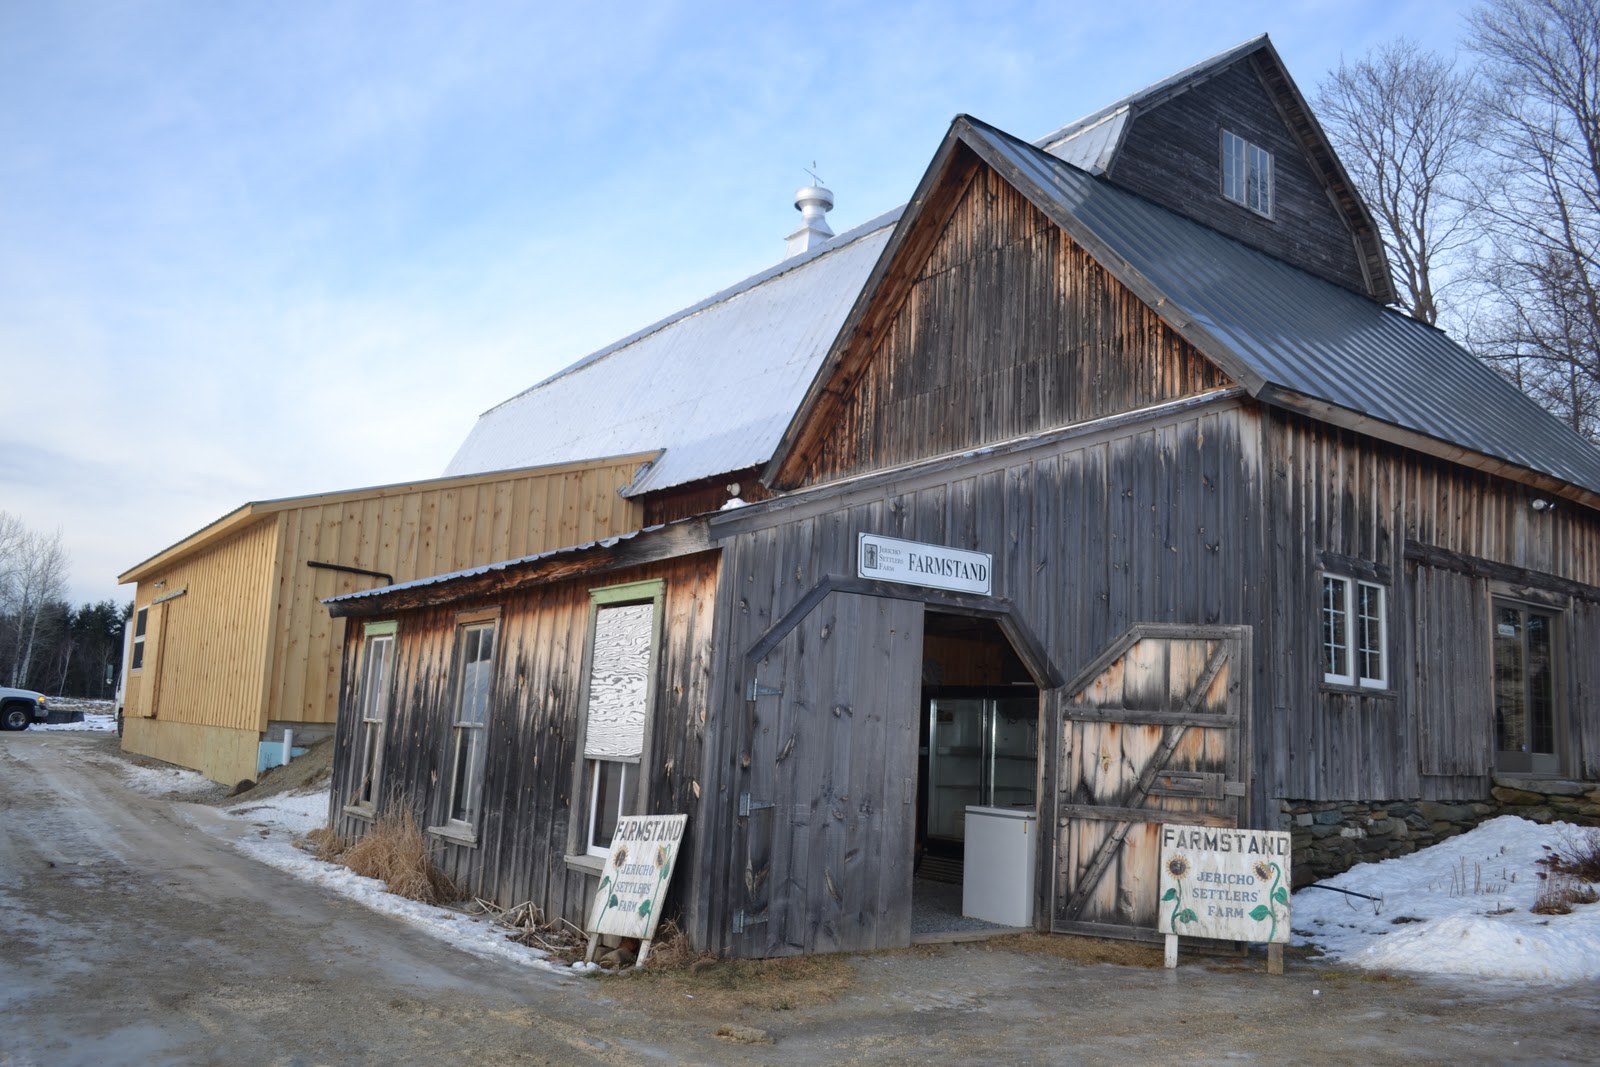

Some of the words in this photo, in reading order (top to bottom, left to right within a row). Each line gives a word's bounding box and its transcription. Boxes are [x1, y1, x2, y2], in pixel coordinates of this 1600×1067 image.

[879, 563, 895, 572] FARM
[908, 553, 987, 582] FARMSTAND
[614, 820, 683, 842] FARMSTAND
[1163, 829, 1290, 856] FARMSTAND
[621, 864, 655, 876] JERICHO
[1196, 872, 1255, 886] JERICHO
[615, 882, 652, 895] SETTLERS
[618, 900, 638, 913] FARM
[1207, 905, 1244, 919] FARM
